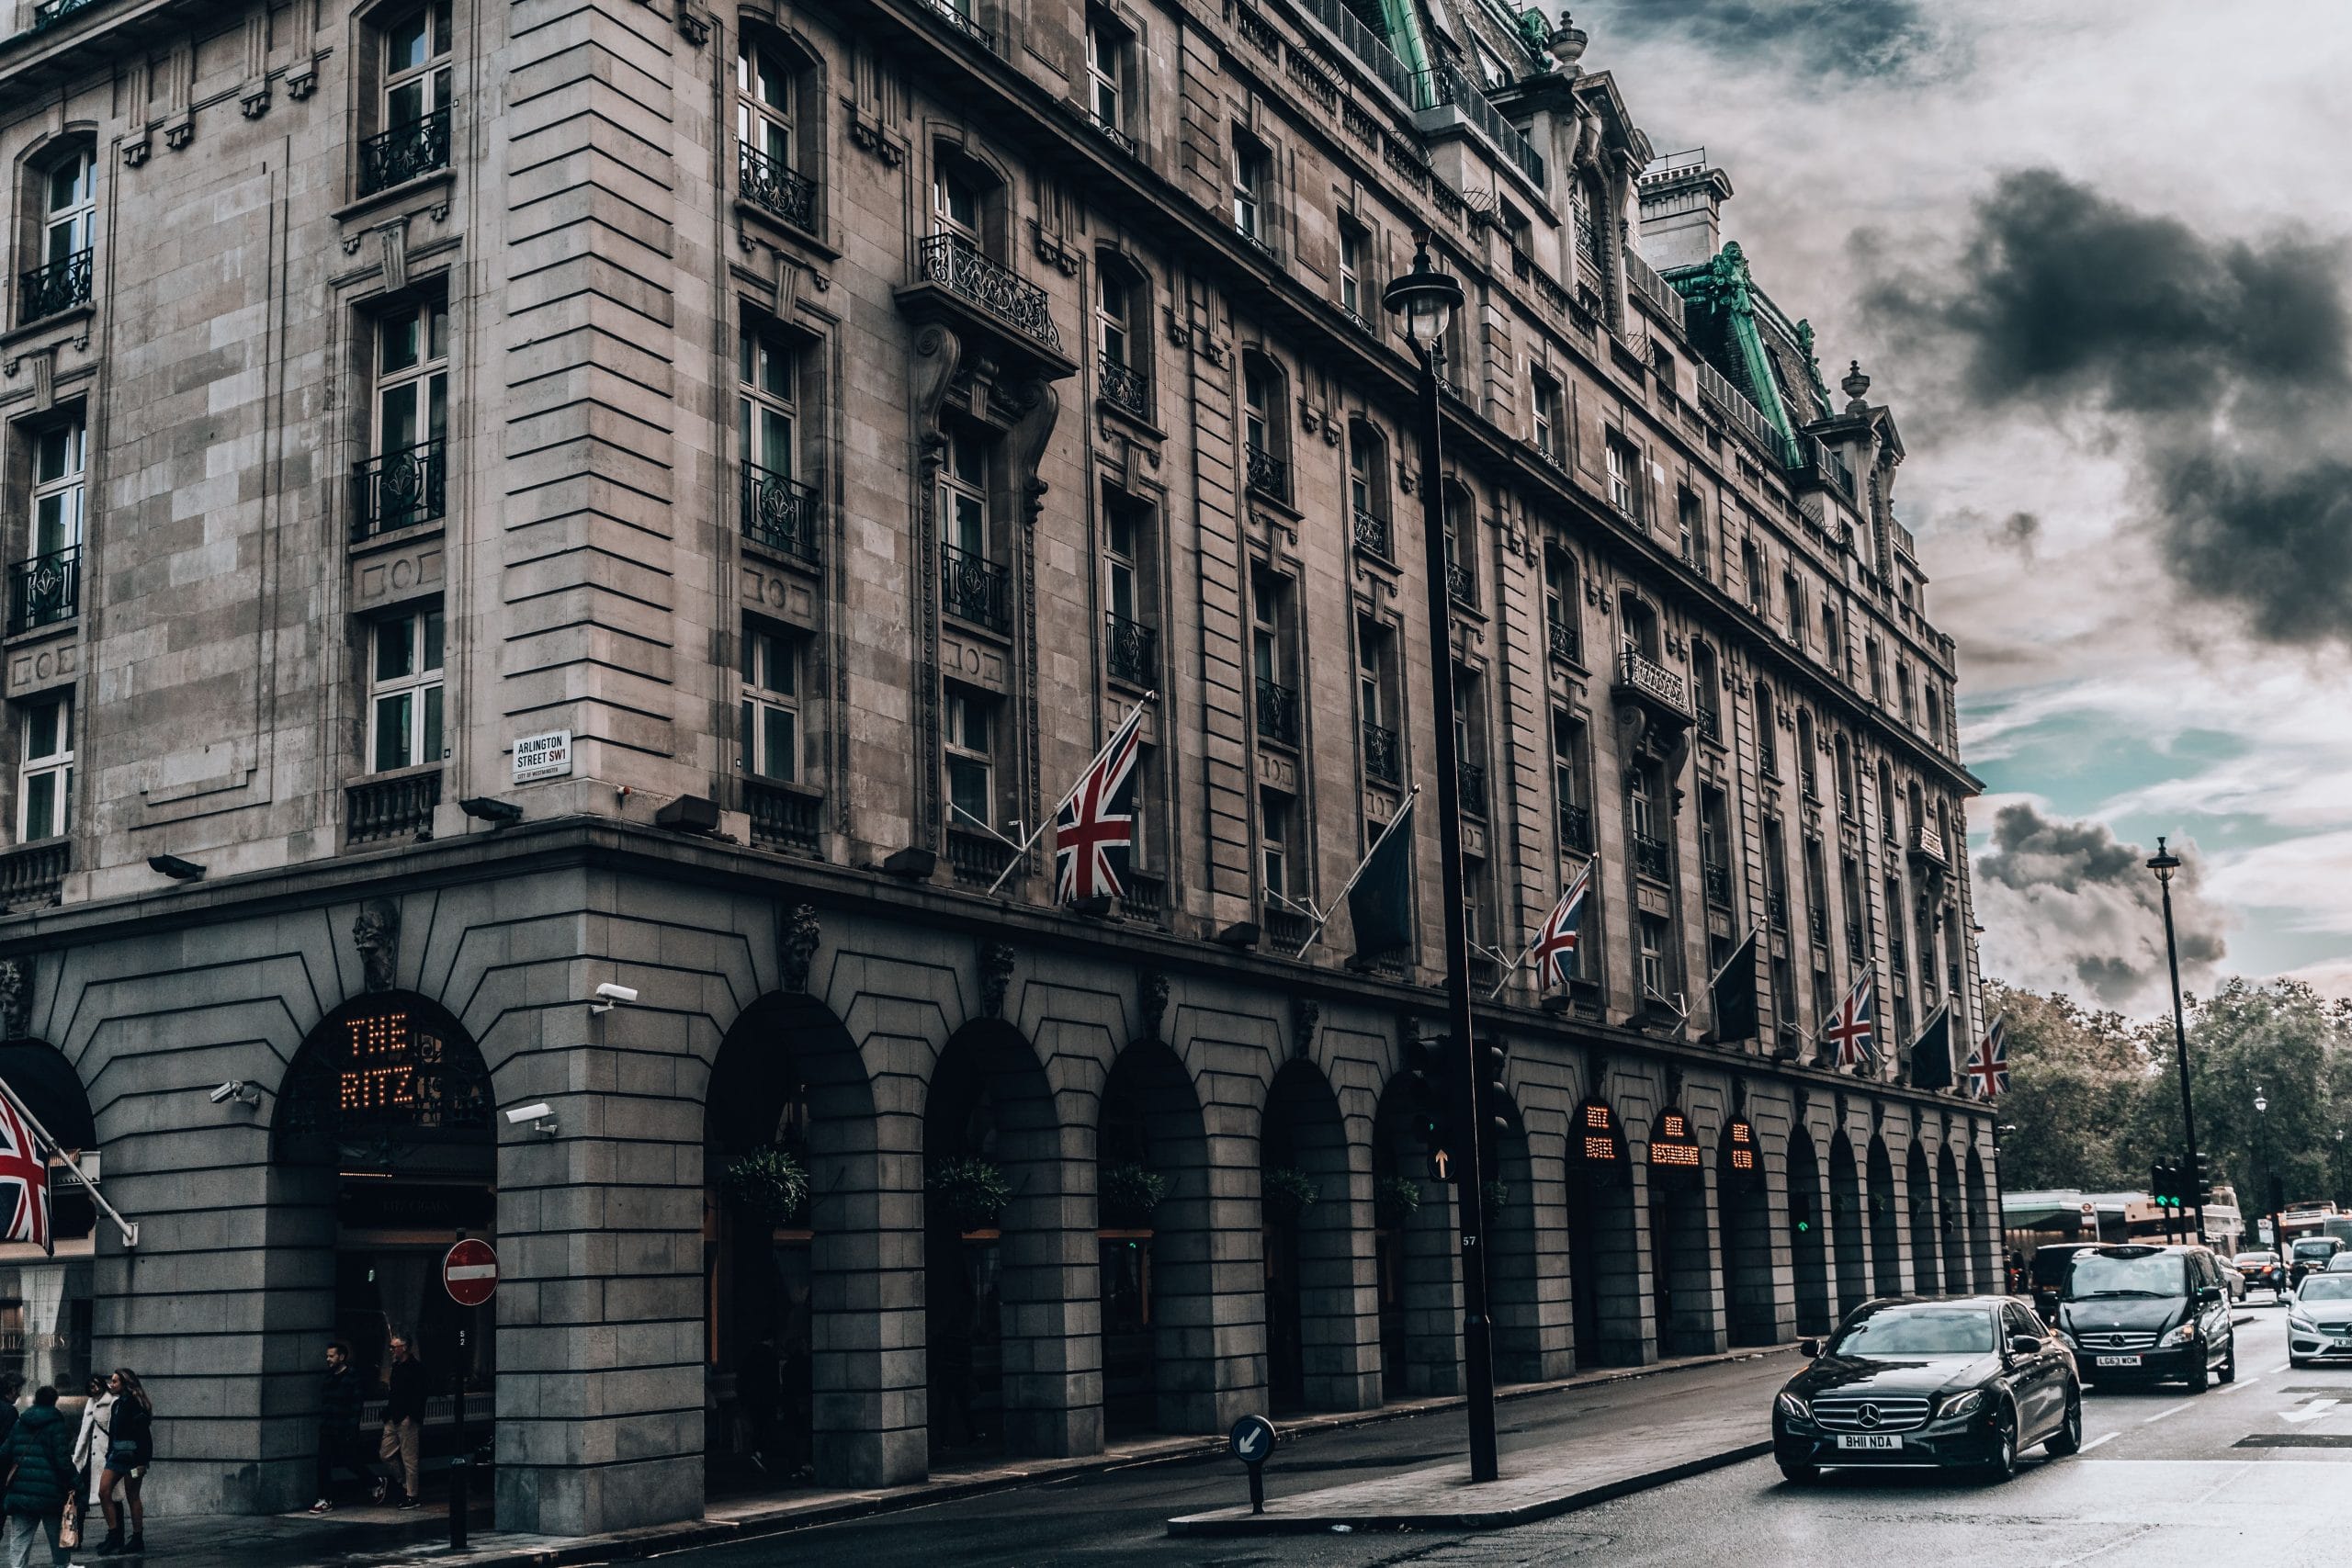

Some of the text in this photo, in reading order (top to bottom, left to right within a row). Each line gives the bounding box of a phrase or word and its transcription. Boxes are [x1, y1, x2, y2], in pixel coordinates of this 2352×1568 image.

[518, 736, 562, 754] ARLINGTON
[517, 749, 566, 768] STREET SW1
[533, 767, 559, 776] WESTMINSTER
[345, 1013, 407, 1056] THE
[341, 1066, 413, 1110] RITZ
[1587, 1106, 1609, 1128] RITZ
[1665, 1116, 1684, 1137] RITZ
[1733, 1123, 1749, 1143] RITZ
[1585, 1137, 1615, 1159] HOTEL
[1651, 1143, 1699, 1166] RESTAURANT
[1732, 1150, 1753, 1169] CLUB
[1463, 1235, 1476, 1247] 57
[1870, 1436, 1893, 1448] NDA
